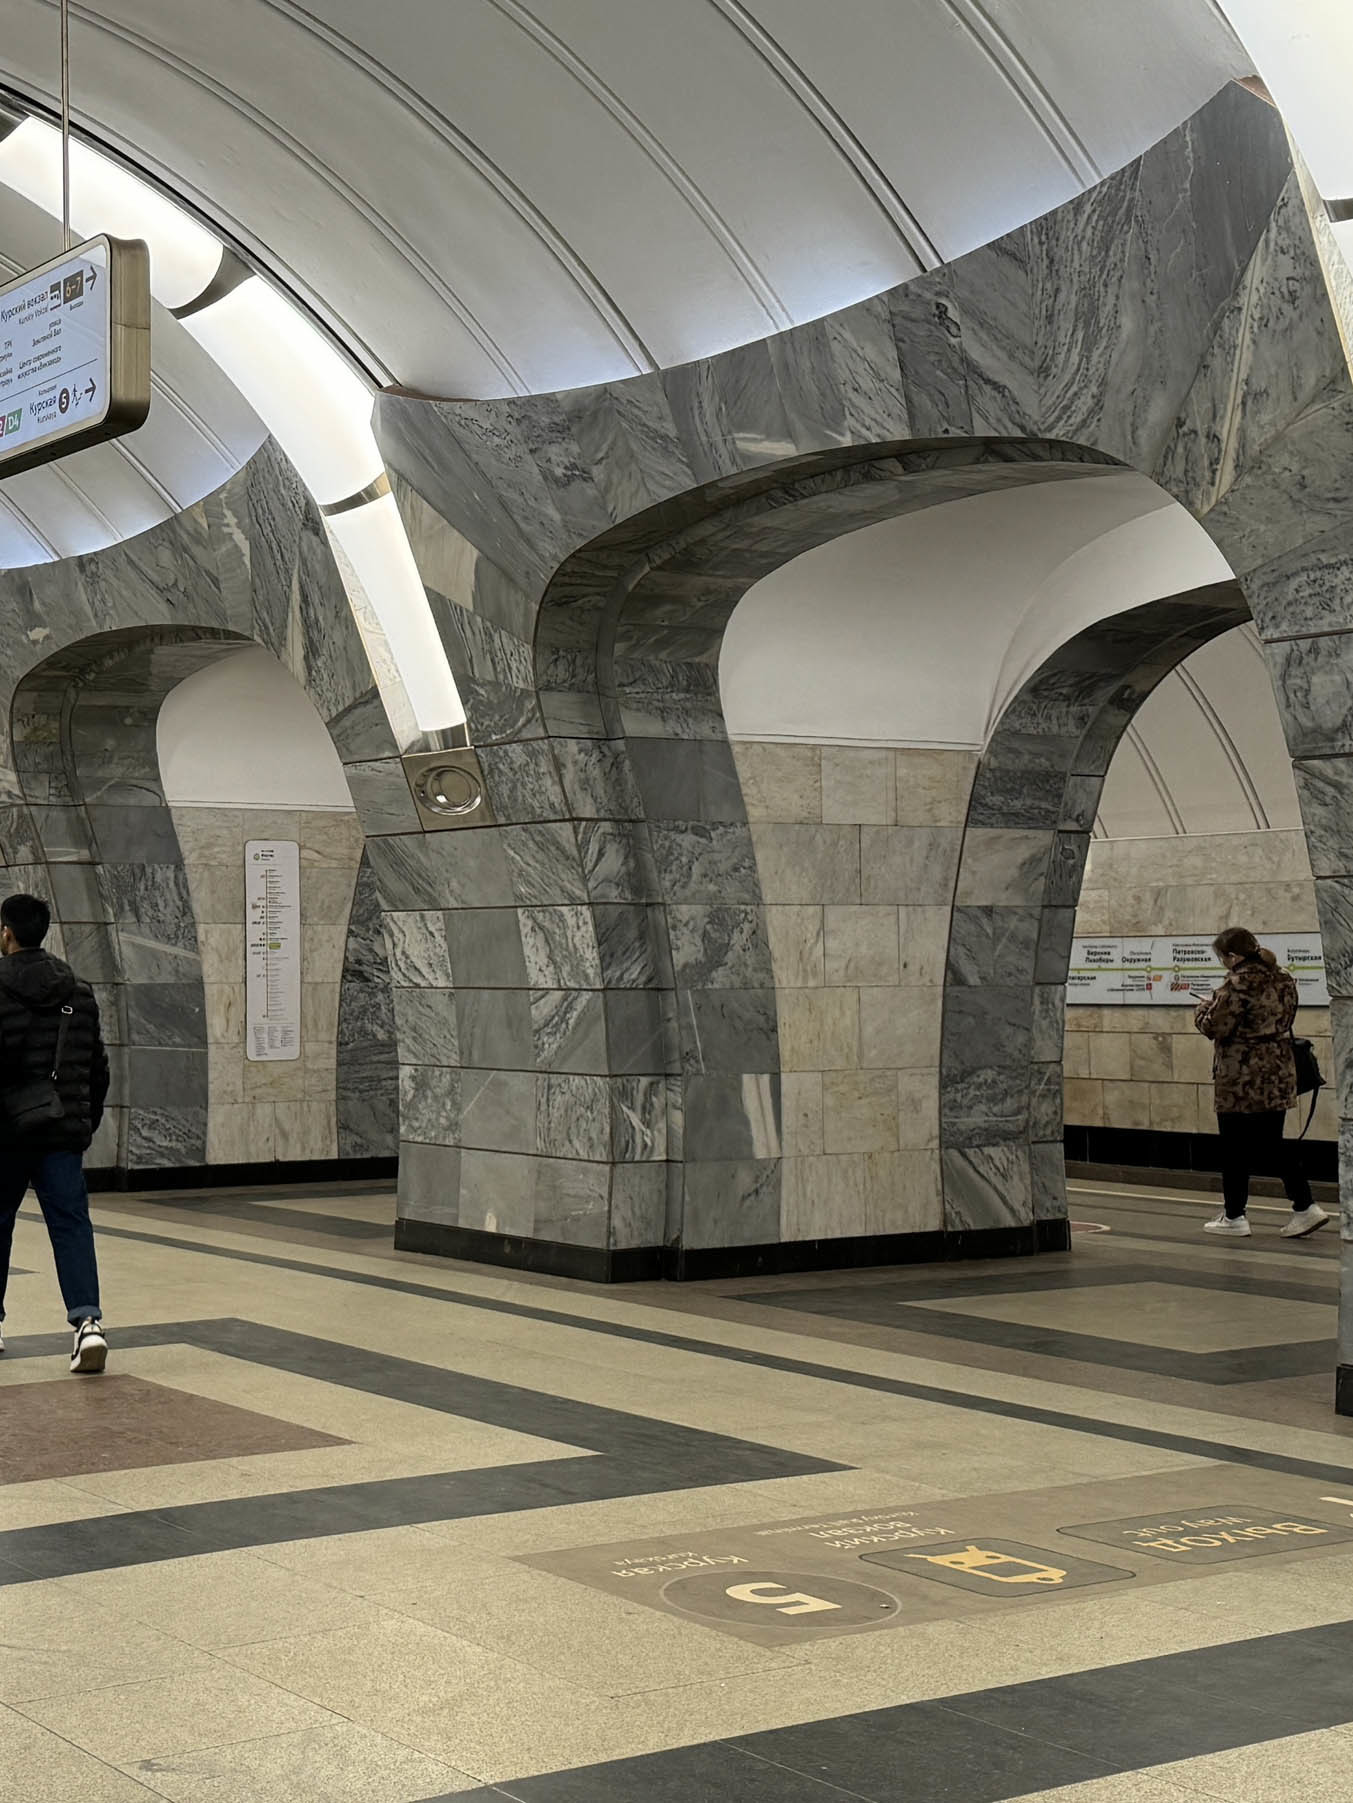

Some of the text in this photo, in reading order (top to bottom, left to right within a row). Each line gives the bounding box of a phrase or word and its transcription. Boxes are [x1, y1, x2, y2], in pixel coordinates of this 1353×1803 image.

[0, 299, 26, 322] Курский
[30, 396, 57, 416] Курская
[8, 413, 20, 429] D4
[809, 1521, 912, 1539] вокзал
[824, 1526, 955, 1549] Курский
[1123, 1516, 1253, 1537] Way out
[1132, 1522, 1329, 1552] Выход
[612, 1554, 749, 1578] Курская
[726, 1581, 842, 1616] 5
